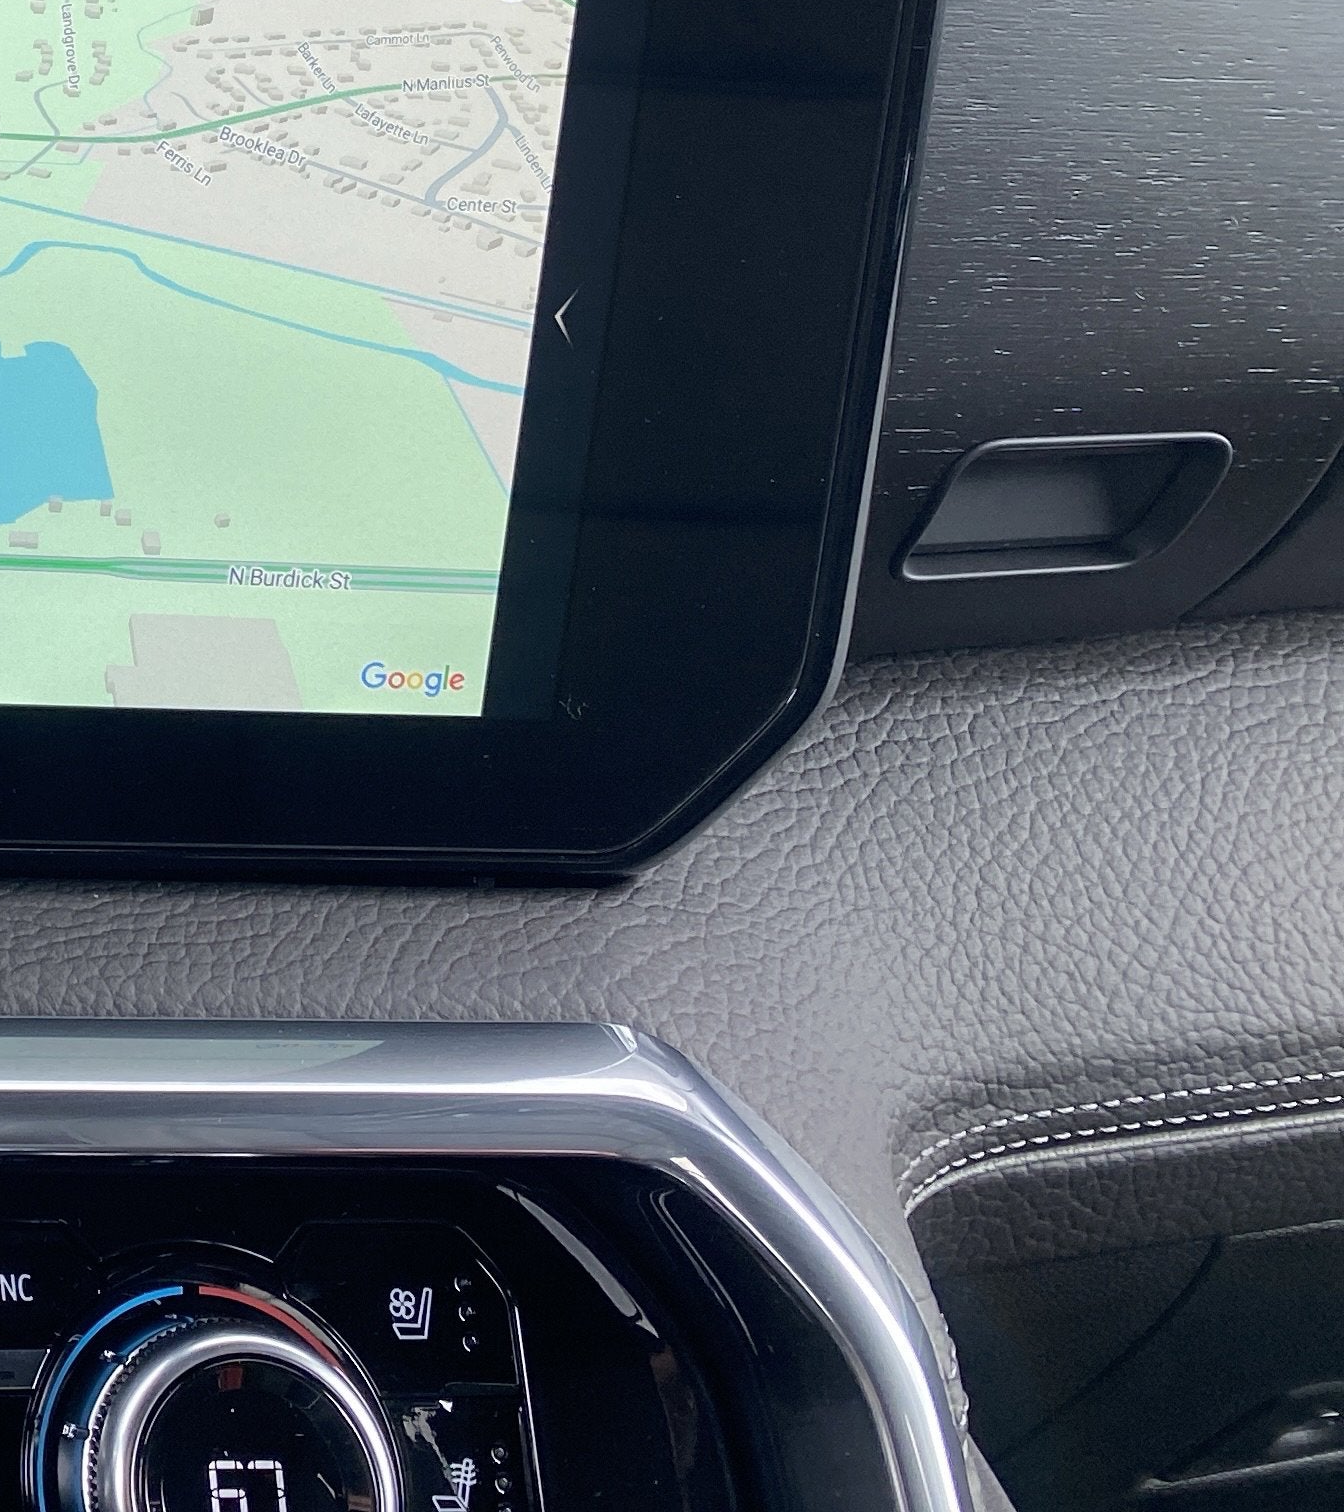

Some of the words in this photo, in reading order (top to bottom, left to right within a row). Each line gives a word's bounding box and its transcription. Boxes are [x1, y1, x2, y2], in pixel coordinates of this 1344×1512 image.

[61, 4, 76, 72] Landgrove
[415, 33, 429, 43] Ln
[68, 75, 80, 89] Dr
[298, 42, 325, 79] Barker
[321, 75, 336, 93] Ln
[402, 80, 415, 92] N
[416, 76, 472, 90] Manlius
[475, 74, 490, 87] St
[490, 36, 529, 82] Penwood
[526, 78, 541, 93] Ln
[355, 104, 411, 141] Lafayette
[412, 132, 429, 145] Ln
[156, 141, 193, 173] Ferris
[193, 169, 212, 187] Ln
[219, 126, 286, 161] Brooklea
[287, 150, 306, 167] Dr
[515, 135, 544, 179] Linden
[447, 197, 497, 212] Center
[501, 200, 517, 214] St
[229, 567, 245, 585] N
[250, 568, 323, 589] Burdick
[329, 572, 351, 590] St
[361, 661, 465, 698] Google
